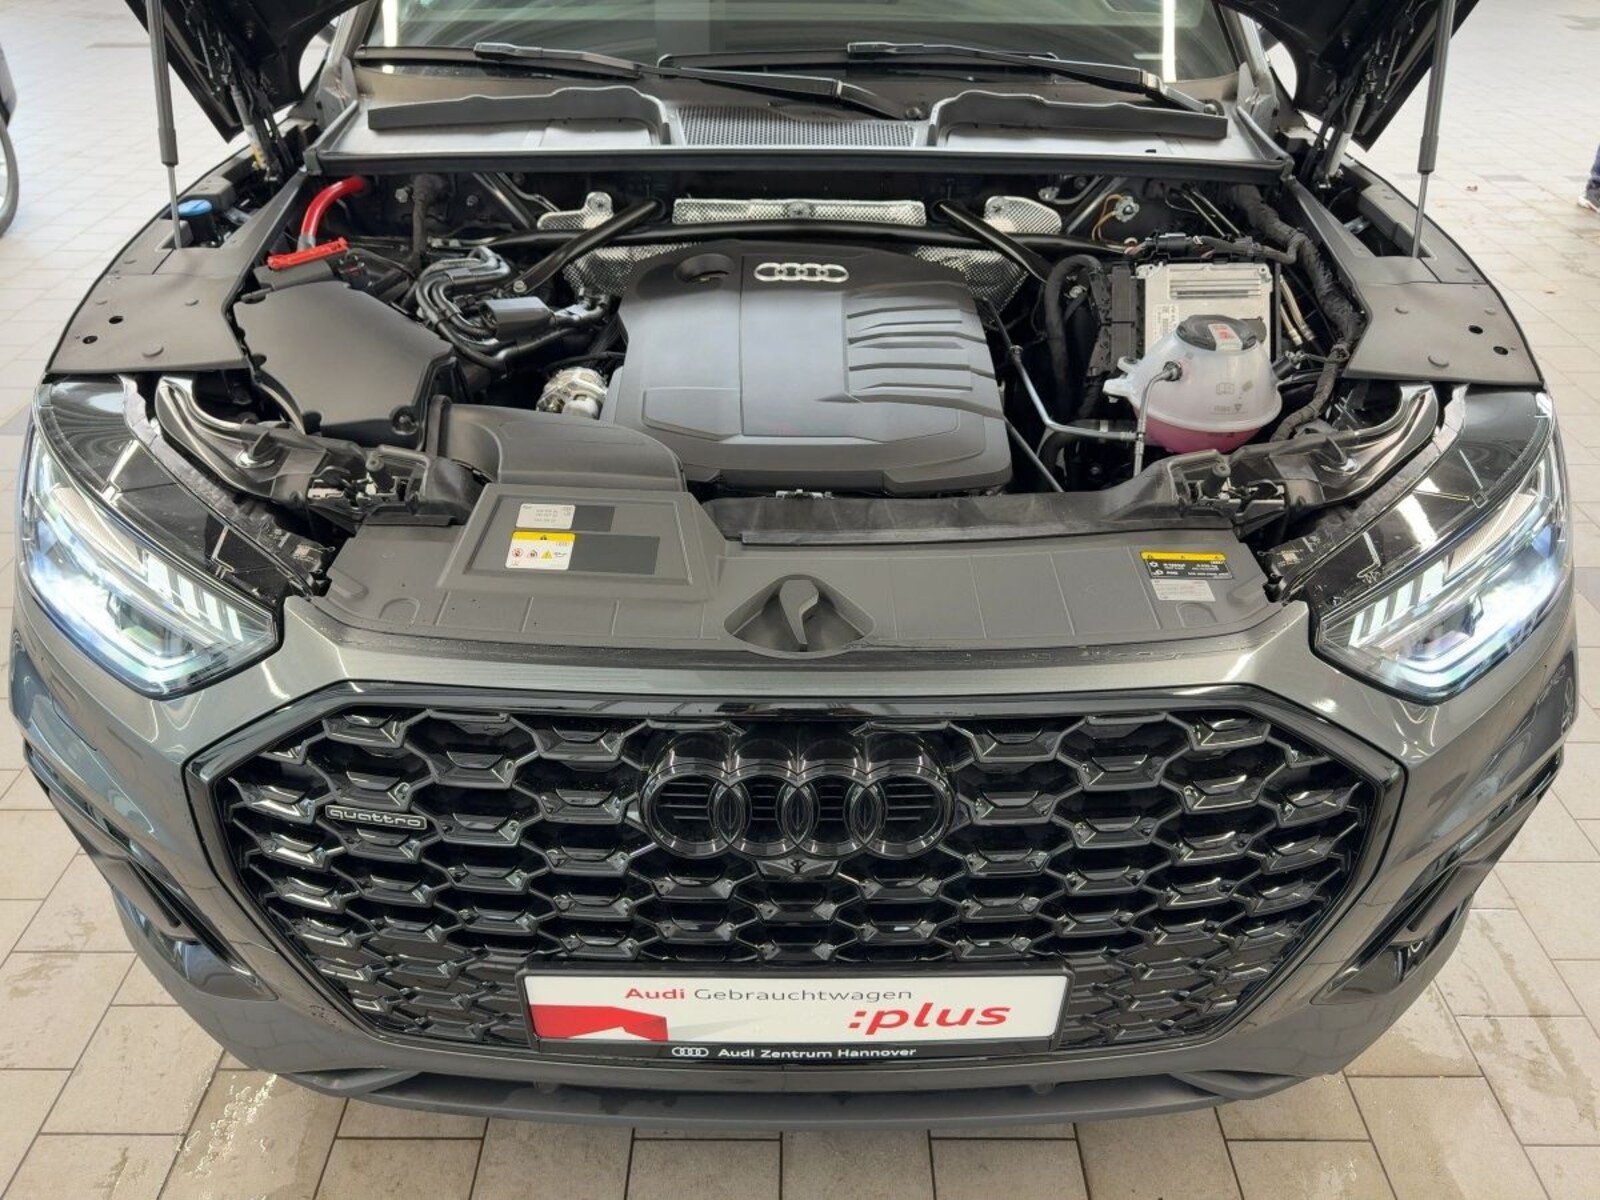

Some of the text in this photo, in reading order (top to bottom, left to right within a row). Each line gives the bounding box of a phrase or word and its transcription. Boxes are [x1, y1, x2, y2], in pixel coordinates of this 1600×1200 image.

[329, 808, 421, 827] quattro
[625, 988, 912, 1003] Audi Gebrauchtwagen
[848, 1002, 1011, 1035] :plus
[717, 1048, 917, 1059] Audi Zentrum Hannover
